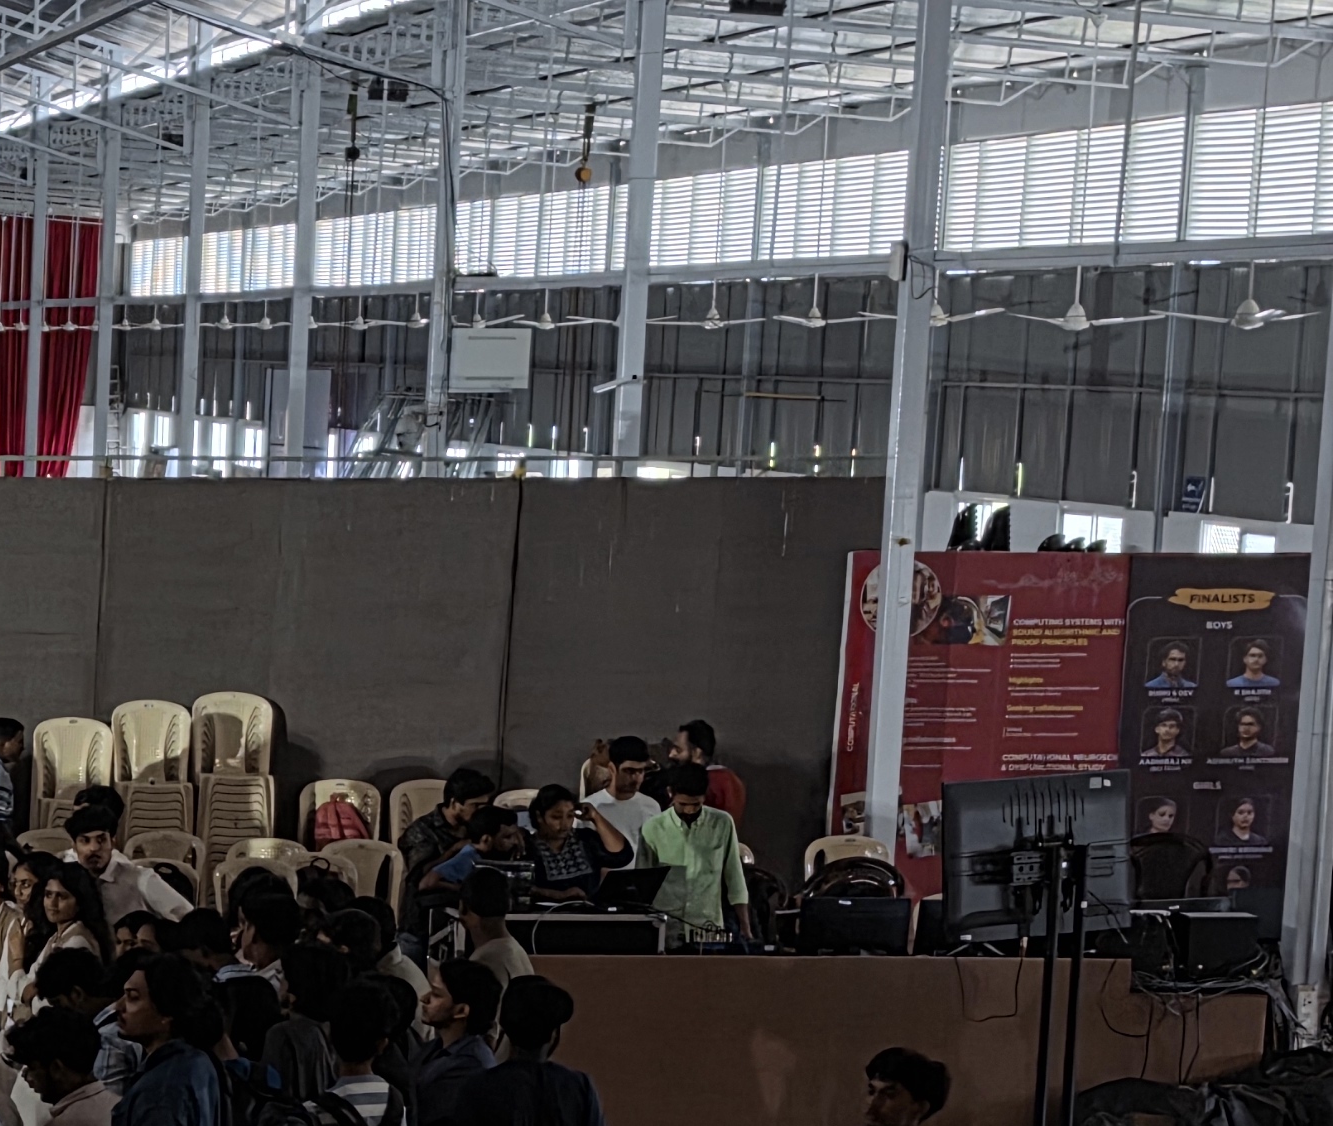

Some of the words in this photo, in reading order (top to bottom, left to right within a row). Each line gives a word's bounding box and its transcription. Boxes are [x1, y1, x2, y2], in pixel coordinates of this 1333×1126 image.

[1189, 593, 1255, 604] FINALISTS
[1013, 618, 1064, 626] COMPUTING
[1064, 618, 1102, 626] SYSTEMS
[1103, 618, 1125, 626] WITH
[1206, 620, 1233, 629] BOYS
[1002, 753, 1071, 761] COMPUTATIONAL
